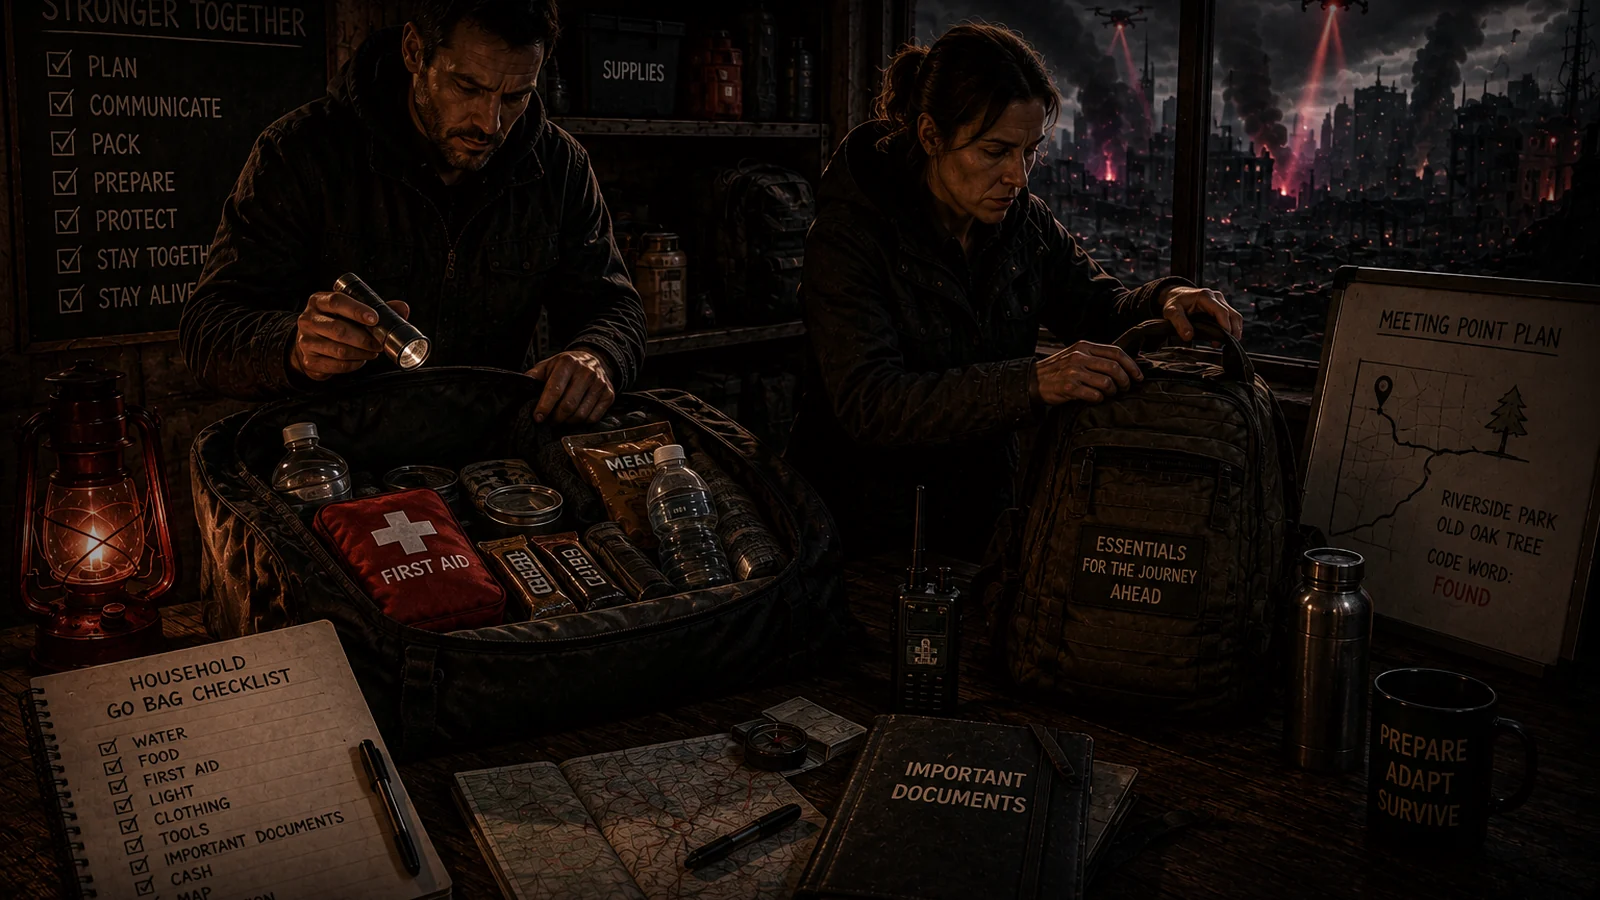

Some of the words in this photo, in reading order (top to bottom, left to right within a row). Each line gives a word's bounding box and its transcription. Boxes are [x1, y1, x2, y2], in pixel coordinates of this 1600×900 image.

[42, 0, 180, 29] STRONGER
[191, 1, 307, 37] TOGETHER
[88, 55, 138, 79] PLAN
[602, 59, 665, 83] SUPPLIES
[89, 94, 223, 119] COMMUNICATE
[91, 132, 141, 155] PACK
[94, 170, 176, 193] PREPARE
[96, 208, 178, 232] PROTECT
[97, 247, 140, 271] STAY
[146, 244, 212, 268] TOGETH
[99, 286, 142, 309] STAY
[1378, 309, 1450, 335] MEETING
[1457, 317, 1509, 341] POINT
[1513, 322, 1562, 349] PLAN
[604, 451, 655, 472] MEAL
[1441, 489, 1513, 521] RIVERSIDE
[1518, 506, 1559, 531] PARK
[1096, 535, 1188, 561] ESSENTIALS
[1437, 516, 1465, 536] OLD
[1470, 524, 1501, 546] OAK
[1506, 531, 1544, 556] TREE
[380, 558, 434, 585] FIRST
[440, 554, 470, 571] AID
[1082, 557, 1107, 574] FOR
[1110, 560, 1136, 578] THE
[1138, 564, 1198, 585] JOURNEY
[1427, 548, 1463, 572] CODE
[1468, 558, 1513, 584] WORD:
[1109, 583, 1162, 605] AHEAD
[1432, 575, 1491, 607] FOUND
[129, 655, 246, 692] HOUSEHOLD
[107, 701, 134, 719] GO
[142, 691, 183, 713] BAG
[192, 668, 291, 701] CHECKLIST
[132, 727, 188, 749] WATER
[1380, 723, 1469, 763] PREPARE
[138, 748, 180, 768] FOOD
[143, 766, 186, 787] FIRST
[195, 760, 220, 777] AID
[904, 761, 1027, 789] IMPORTANT
[1386, 760, 1455, 795] ADAPT
[149, 784, 195, 806] LIGHT
[891, 784, 1027, 814] DOCUMENTS
[1378, 788, 1461, 827] SURVIVE
[154, 797, 231, 826] CLOTHING
[158, 823, 210, 846] TOOLS
[164, 834, 246, 866] IMPORTANT
[255, 811, 345, 844] DOCUMENTS
[170, 864, 213, 886] CASH
